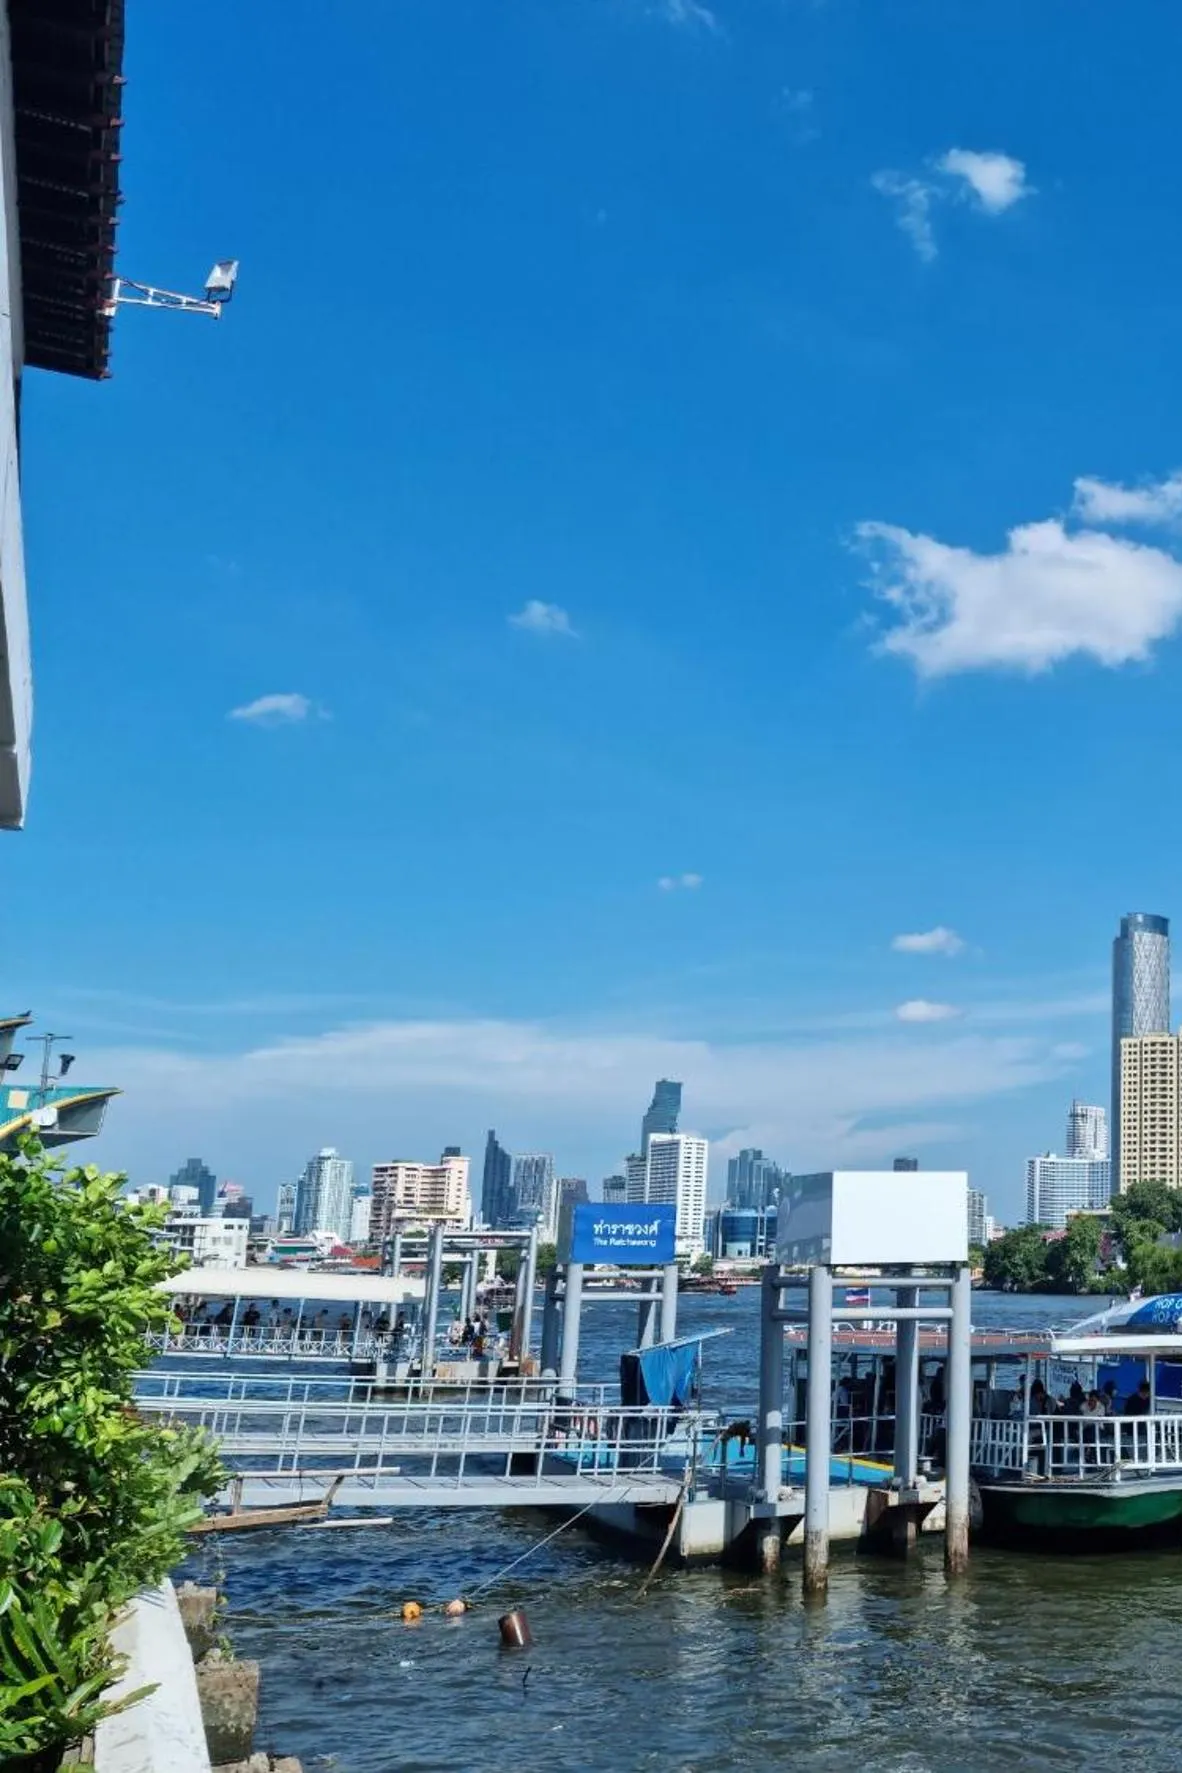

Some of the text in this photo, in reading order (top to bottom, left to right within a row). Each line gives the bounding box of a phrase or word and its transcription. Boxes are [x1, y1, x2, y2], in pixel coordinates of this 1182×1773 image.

[593, 1219, 661, 1236] ท่าราชวงศ์
[1155, 1297, 1175, 1310] HOP
